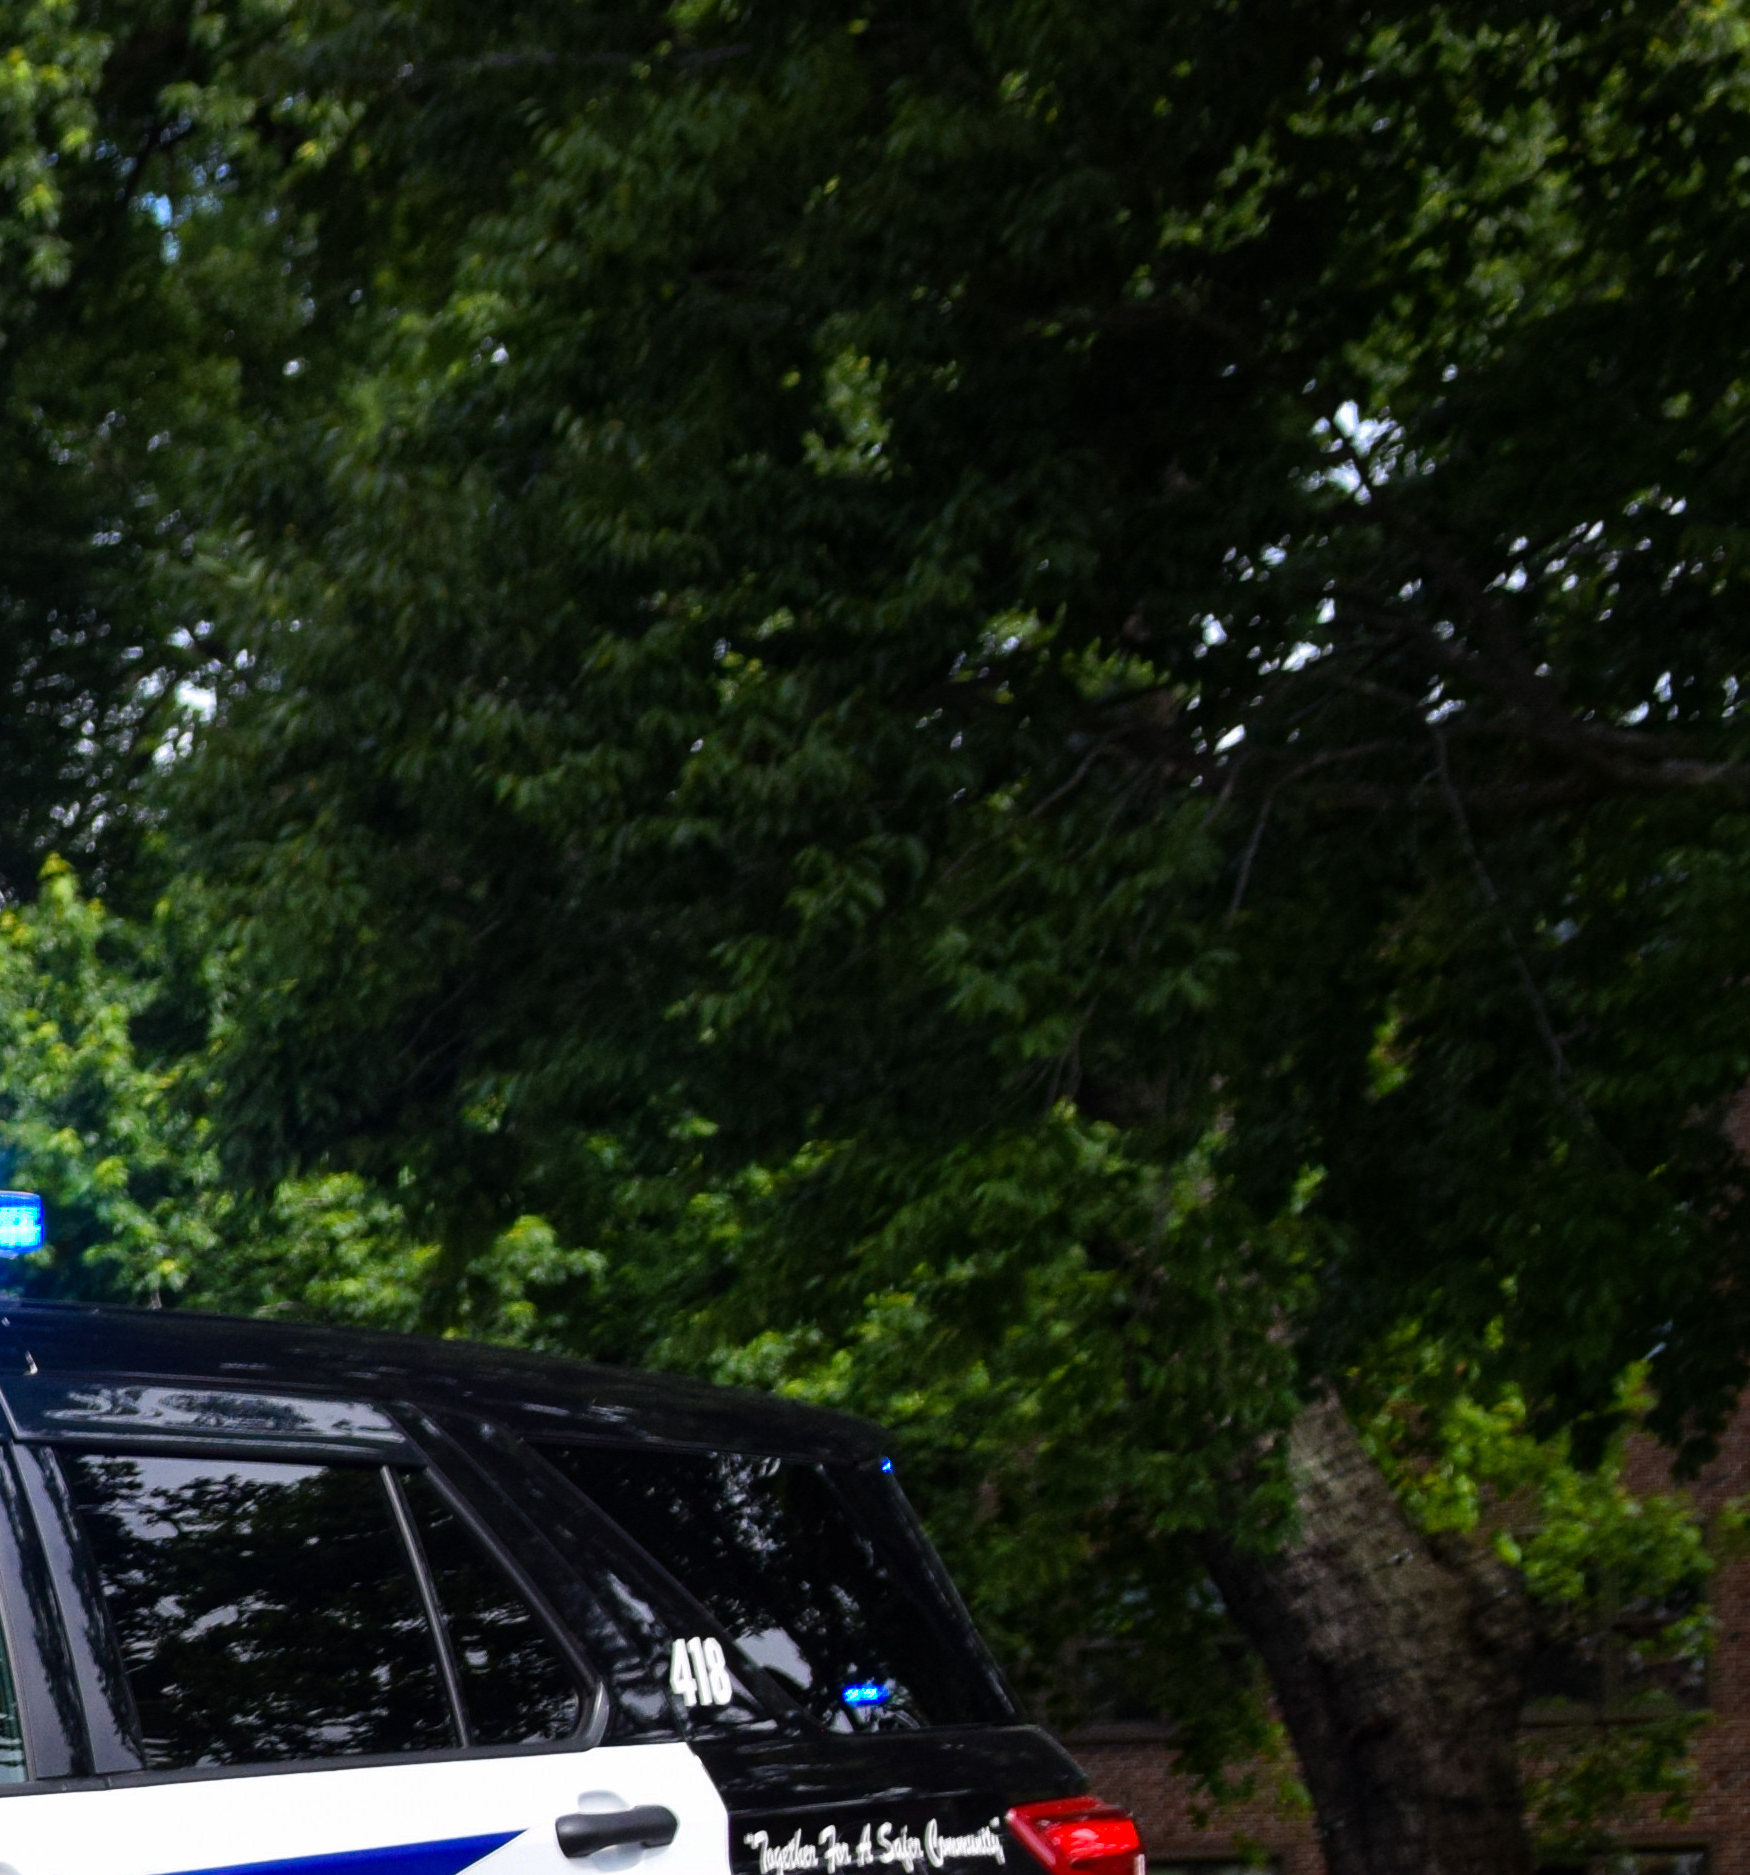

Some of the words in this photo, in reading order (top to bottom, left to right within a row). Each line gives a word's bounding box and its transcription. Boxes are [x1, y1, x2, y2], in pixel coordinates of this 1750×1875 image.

[669, 1636, 732, 1707] 418
[819, 1825, 850, 1874] For
[856, 1823, 873, 1867] A
[878, 1821, 924, 1873] Safer
